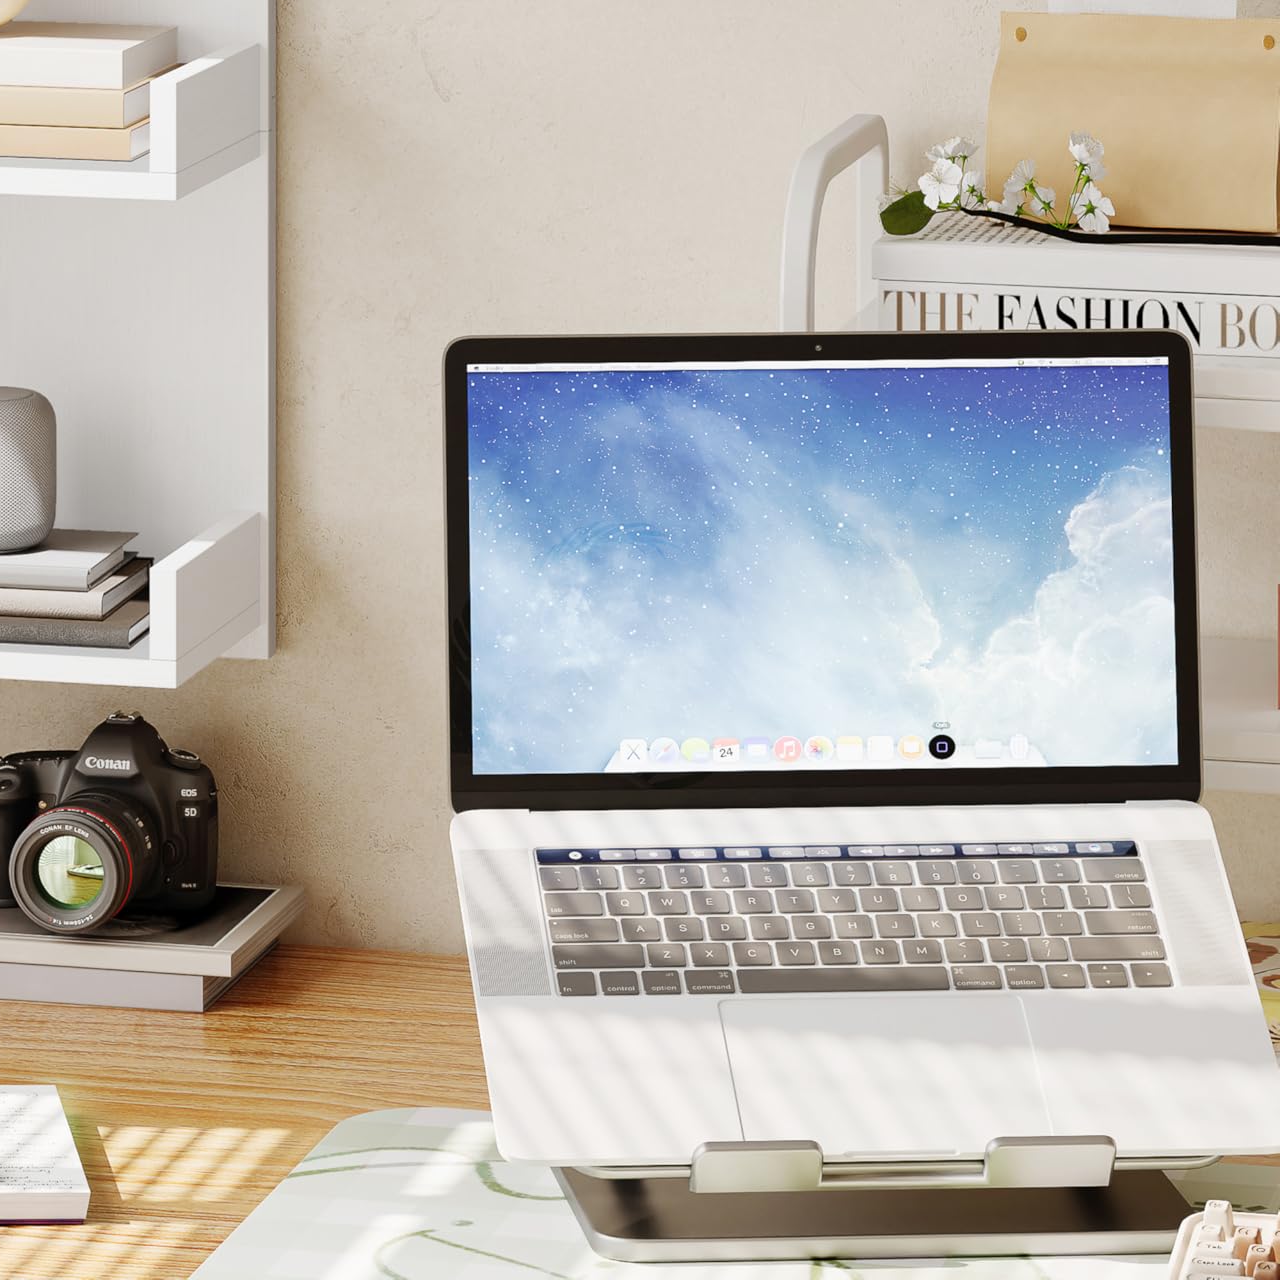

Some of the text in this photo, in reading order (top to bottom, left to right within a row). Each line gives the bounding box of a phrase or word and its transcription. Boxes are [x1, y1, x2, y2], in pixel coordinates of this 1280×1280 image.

[883, 290, 980, 332] THE
[993, 293, 1205, 347] FASHION
[719, 747, 733, 758] 24
[85, 756, 130, 770] Conan
[181, 789, 198, 797] EOS
[184, 808, 197, 817] 5D
[40, 824, 62, 835] CONAN
[74, 827, 89, 838] LENS
[848, 874, 855, 882] 7
[932, 873, 941, 881] 9
[972, 872, 981, 880] 0
[748, 897, 757, 905] R
[831, 896, 840, 904] Y
[958, 894, 968, 902] O
[620, 899, 630, 907] Q
[679, 924, 688, 932] S
[721, 923, 730, 931] D
[806, 922, 815, 930] G
[891, 921, 898, 929] J
[976, 920, 984, 928] L
[636, 925, 646, 933] A
[663, 951, 671, 959] Z
[704, 950, 714, 958] X
[748, 949, 757, 957] C
[790, 949, 800, 957] V
[833, 948, 842, 956] B
[875, 947, 885, 955] N
[916, 947, 928, 955] M
[692, 983, 731, 991] command
[1010, 979, 1037, 987] option
[607, 984, 635, 992] control
[651, 984, 677, 993] option
